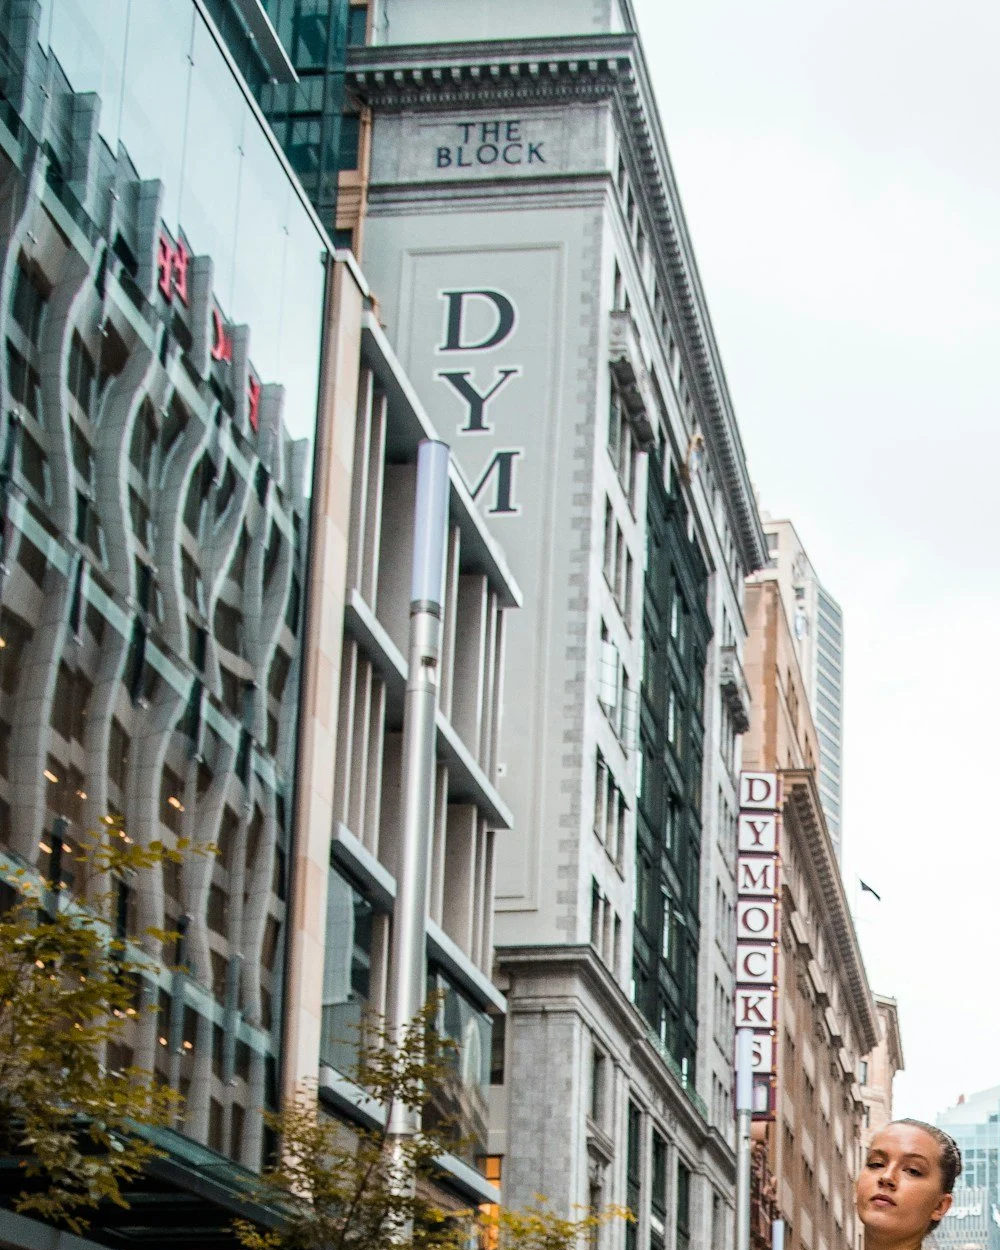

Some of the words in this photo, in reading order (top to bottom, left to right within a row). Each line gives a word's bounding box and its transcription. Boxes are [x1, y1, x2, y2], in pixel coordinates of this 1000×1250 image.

[457, 121, 523, 143] THE
[436, 141, 546, 168] BLOCK
[742, 776, 774, 1067] DYMOCKS
